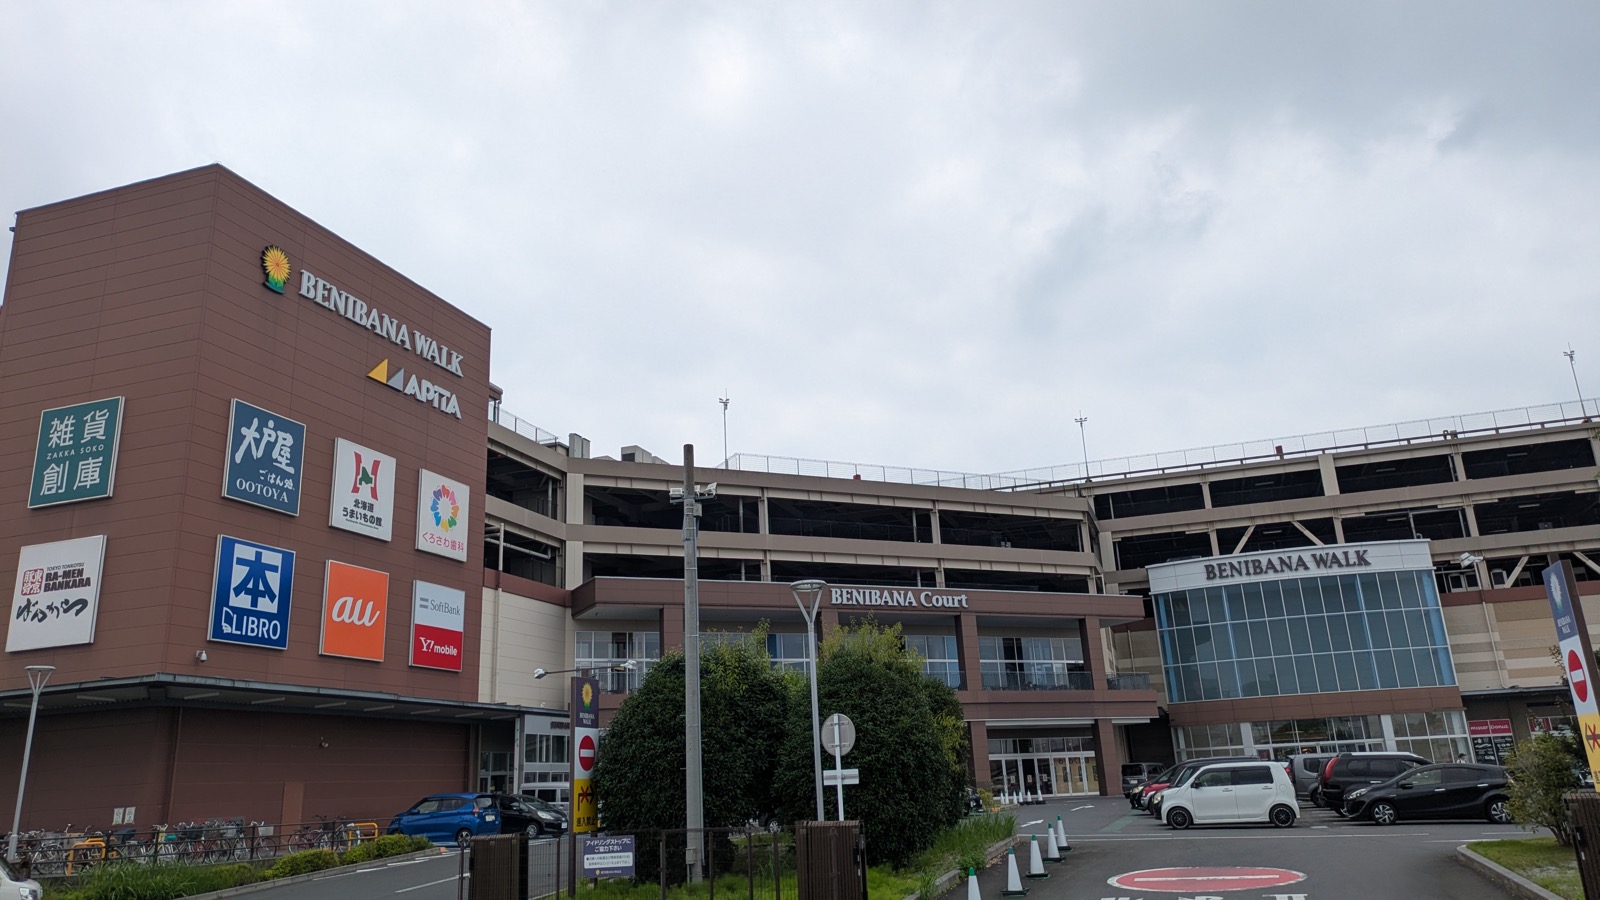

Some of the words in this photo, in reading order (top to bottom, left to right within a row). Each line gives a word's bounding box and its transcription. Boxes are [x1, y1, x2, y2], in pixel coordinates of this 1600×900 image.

[299, 269, 412, 350] BENIBANA
[413, 329, 464, 378] WALK
[404, 374, 462, 419] APITA
[48, 408, 110, 449] 雑貨
[46, 449, 75, 460] ZAKKA
[80, 444, 104, 454] SOKO
[235, 417, 295, 474] 大戸屋
[40, 456, 103, 496] 創庫
[236, 478, 288, 503] OOTOYA
[342, 506, 382, 527] うまいもの館
[353, 498, 374, 513] 北海道
[422, 532, 465, 552] くろさわ歯科
[45, 568, 84, 582] RA-MEN
[1204, 554, 1310, 580] BENIBANA
[1311, 549, 1372, 569] WALK
[43, 577, 91, 592] BANKARA
[232, 550, 279, 609] 本
[429, 599, 461, 616] SoftBank
[831, 587, 918, 607] BENIBANA
[920, 591, 969, 608] Court
[331, 596, 381, 627] au
[232, 613, 281, 640] LIBRO
[585, 838, 631, 847] アイドリングストップに
